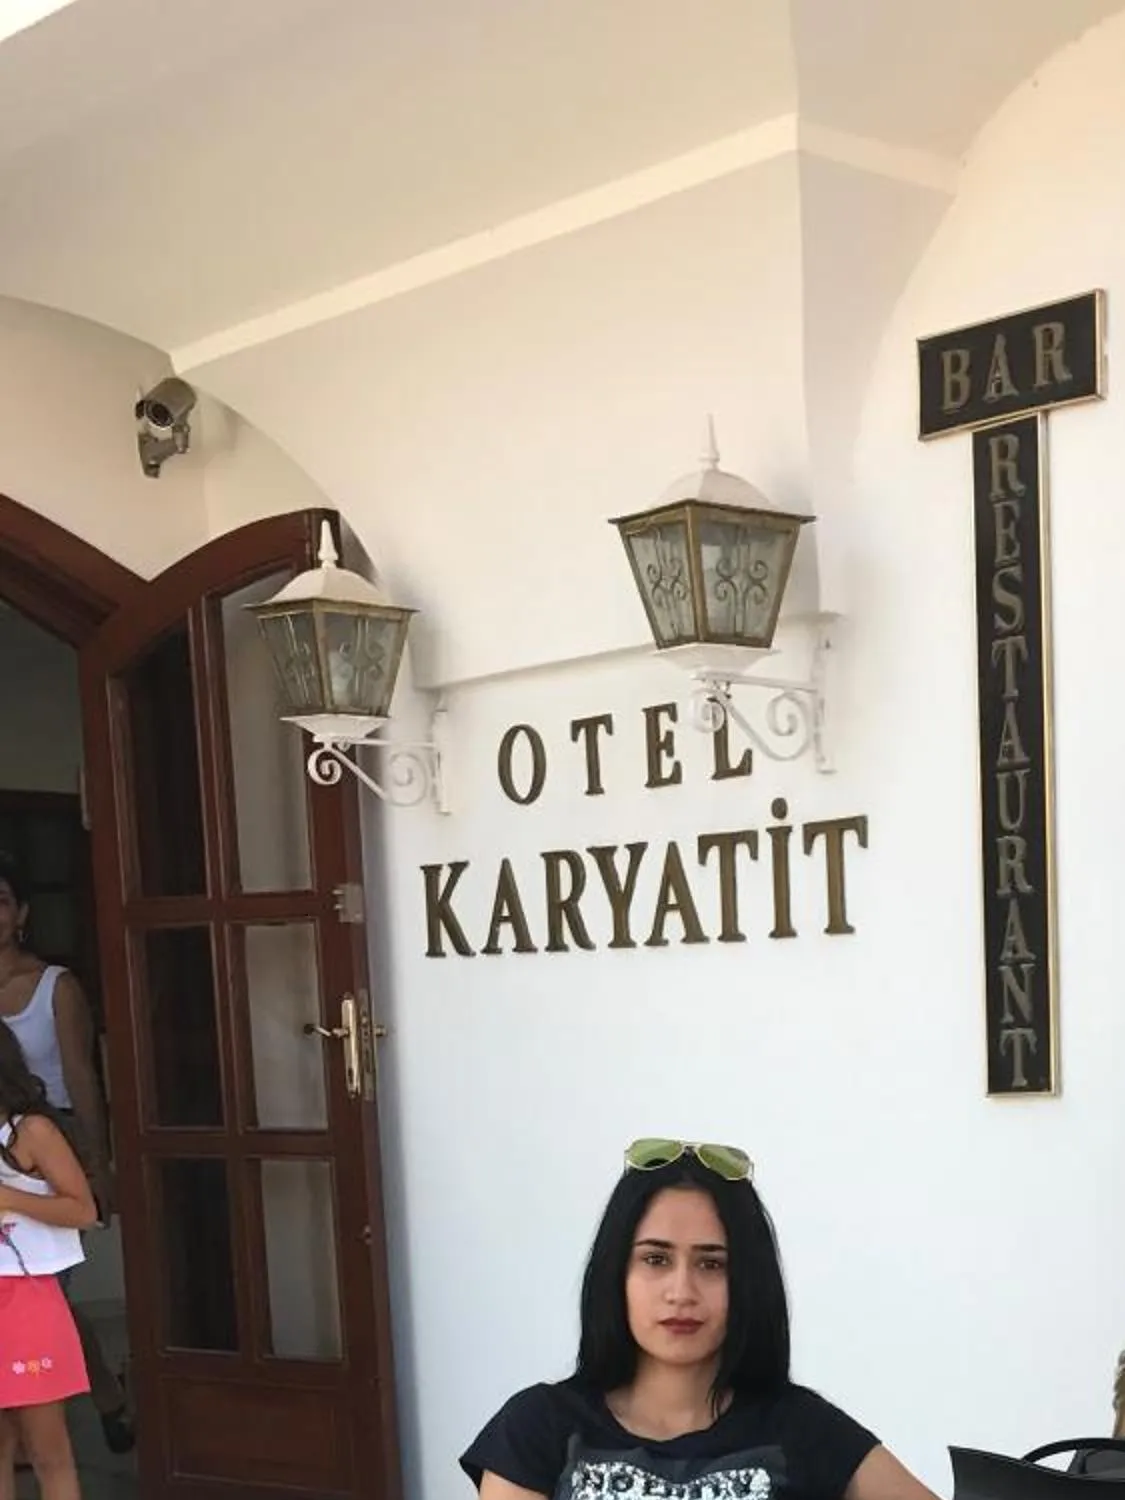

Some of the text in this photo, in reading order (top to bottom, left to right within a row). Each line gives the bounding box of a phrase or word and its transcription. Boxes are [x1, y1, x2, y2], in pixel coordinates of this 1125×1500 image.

[941, 321, 1074, 415] BAR
[497, 697, 754, 806] OTEL
[988, 433, 1038, 1087] RESTAURANT
[419, 797, 869, 958] KARYATİT
